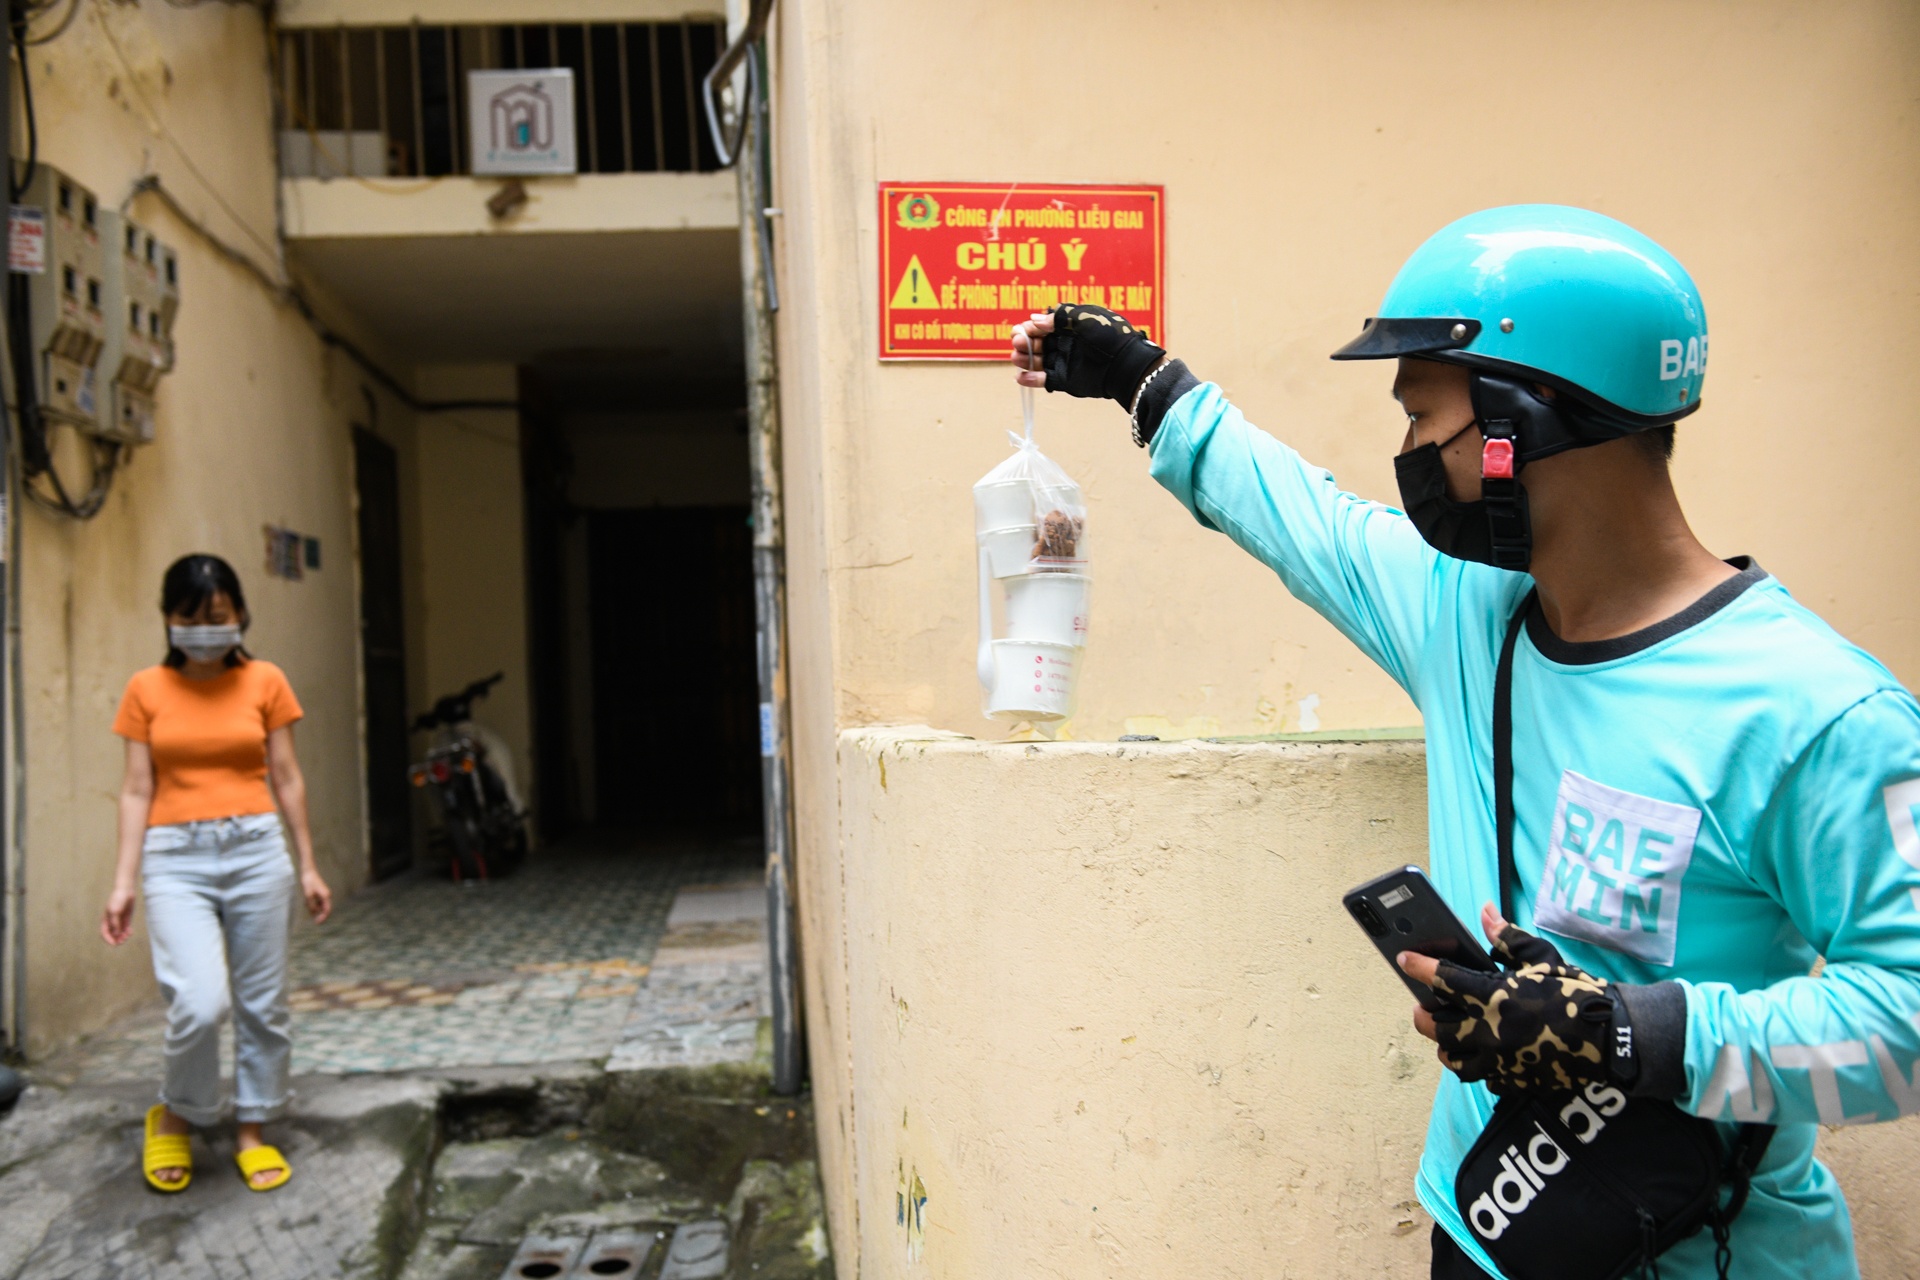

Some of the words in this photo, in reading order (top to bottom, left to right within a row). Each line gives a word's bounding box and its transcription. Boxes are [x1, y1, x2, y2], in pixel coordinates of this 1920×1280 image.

[945, 204, 987, 228] CÔNG
[991, 208, 1012, 228] AN
[1014, 205, 1075, 229] PHƯỜNG
[1113, 210, 1144, 229] GIAI
[956, 237, 1046, 271] CHÚ
[1060, 237, 1088, 271] Ý
[958, 278, 998, 310] PHÒNG
[1000, 276, 1025, 310] MẤT
[1109, 285, 1125, 311] XE
[1126, 281, 1153, 311] MÁY
[1561, 801, 1675, 880] BAE
[1550, 855, 1662, 934] MIN
[1616, 1026, 1631, 1058] 5.11
